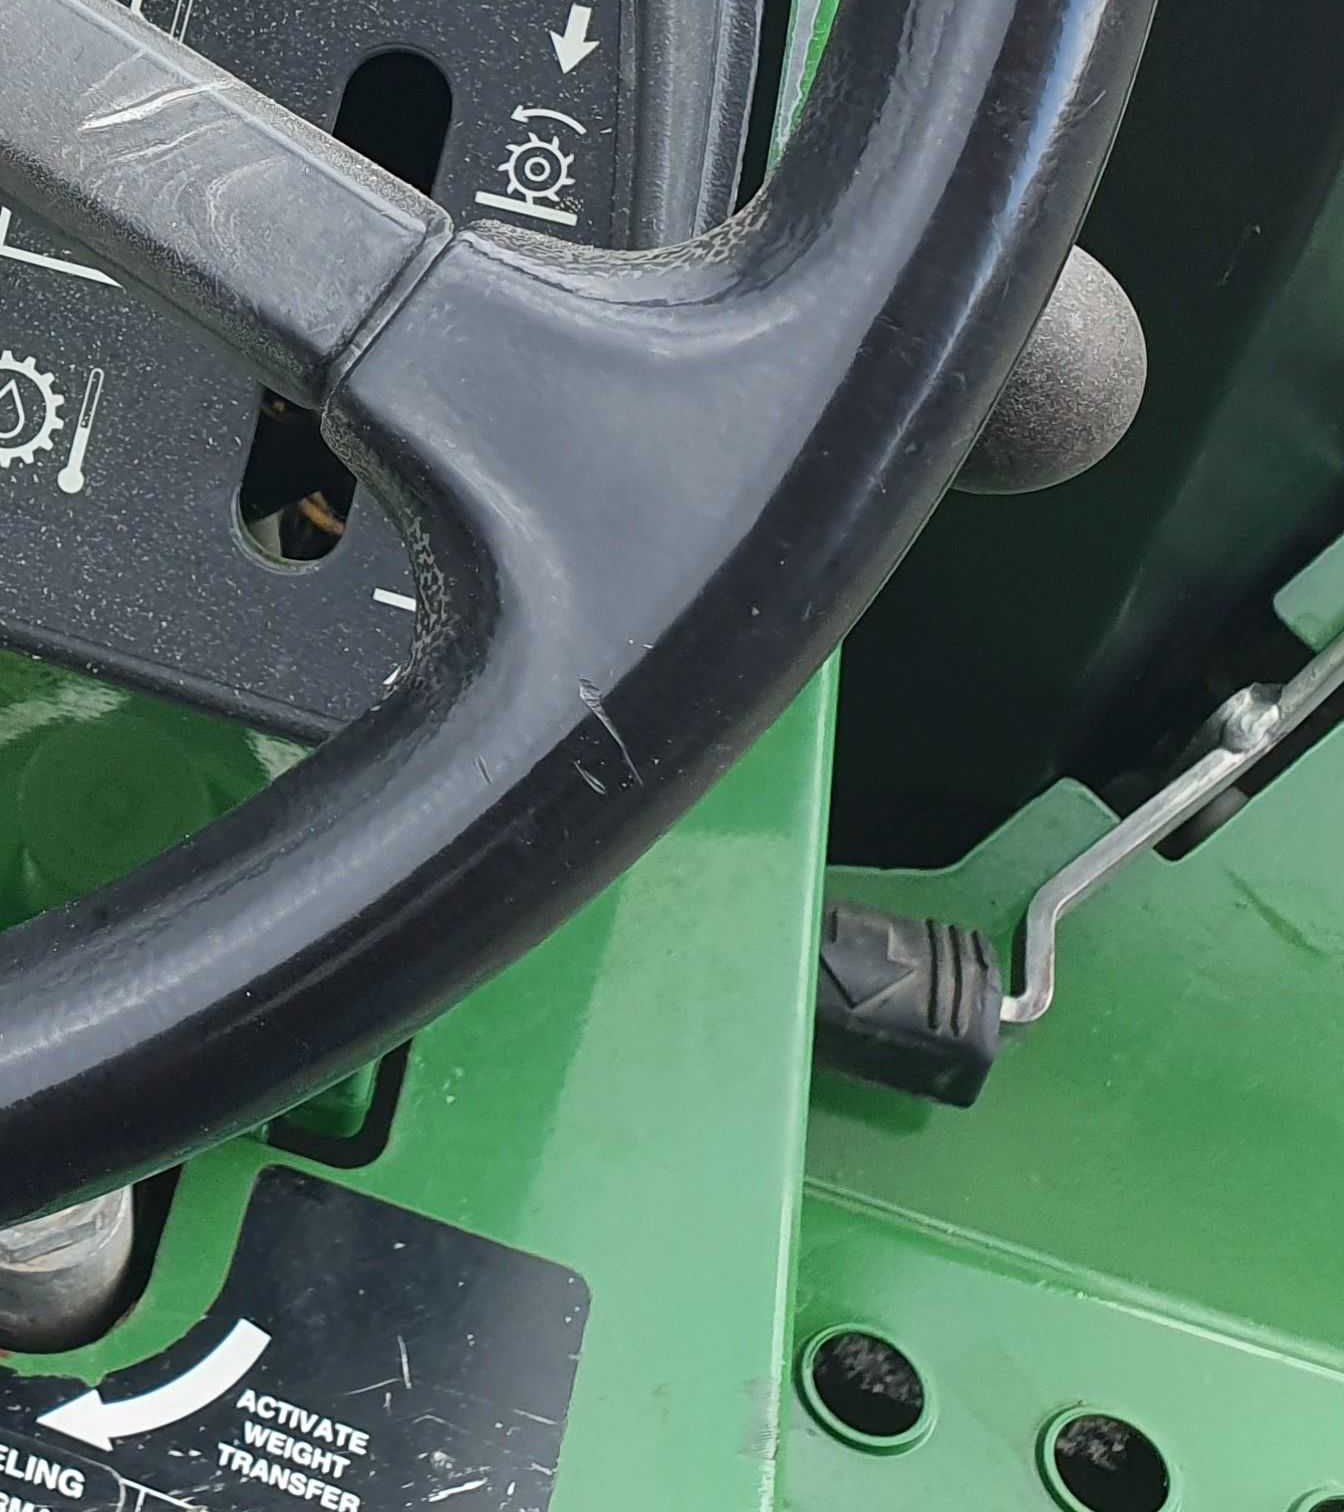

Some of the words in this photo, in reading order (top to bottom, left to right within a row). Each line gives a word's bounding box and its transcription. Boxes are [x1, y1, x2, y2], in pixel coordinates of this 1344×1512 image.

[236, 1388, 370, 1456] ACTIVATE
[243, 1420, 351, 1478] WEIGHT
[217, 1442, 361, 1512] TRANSFER
